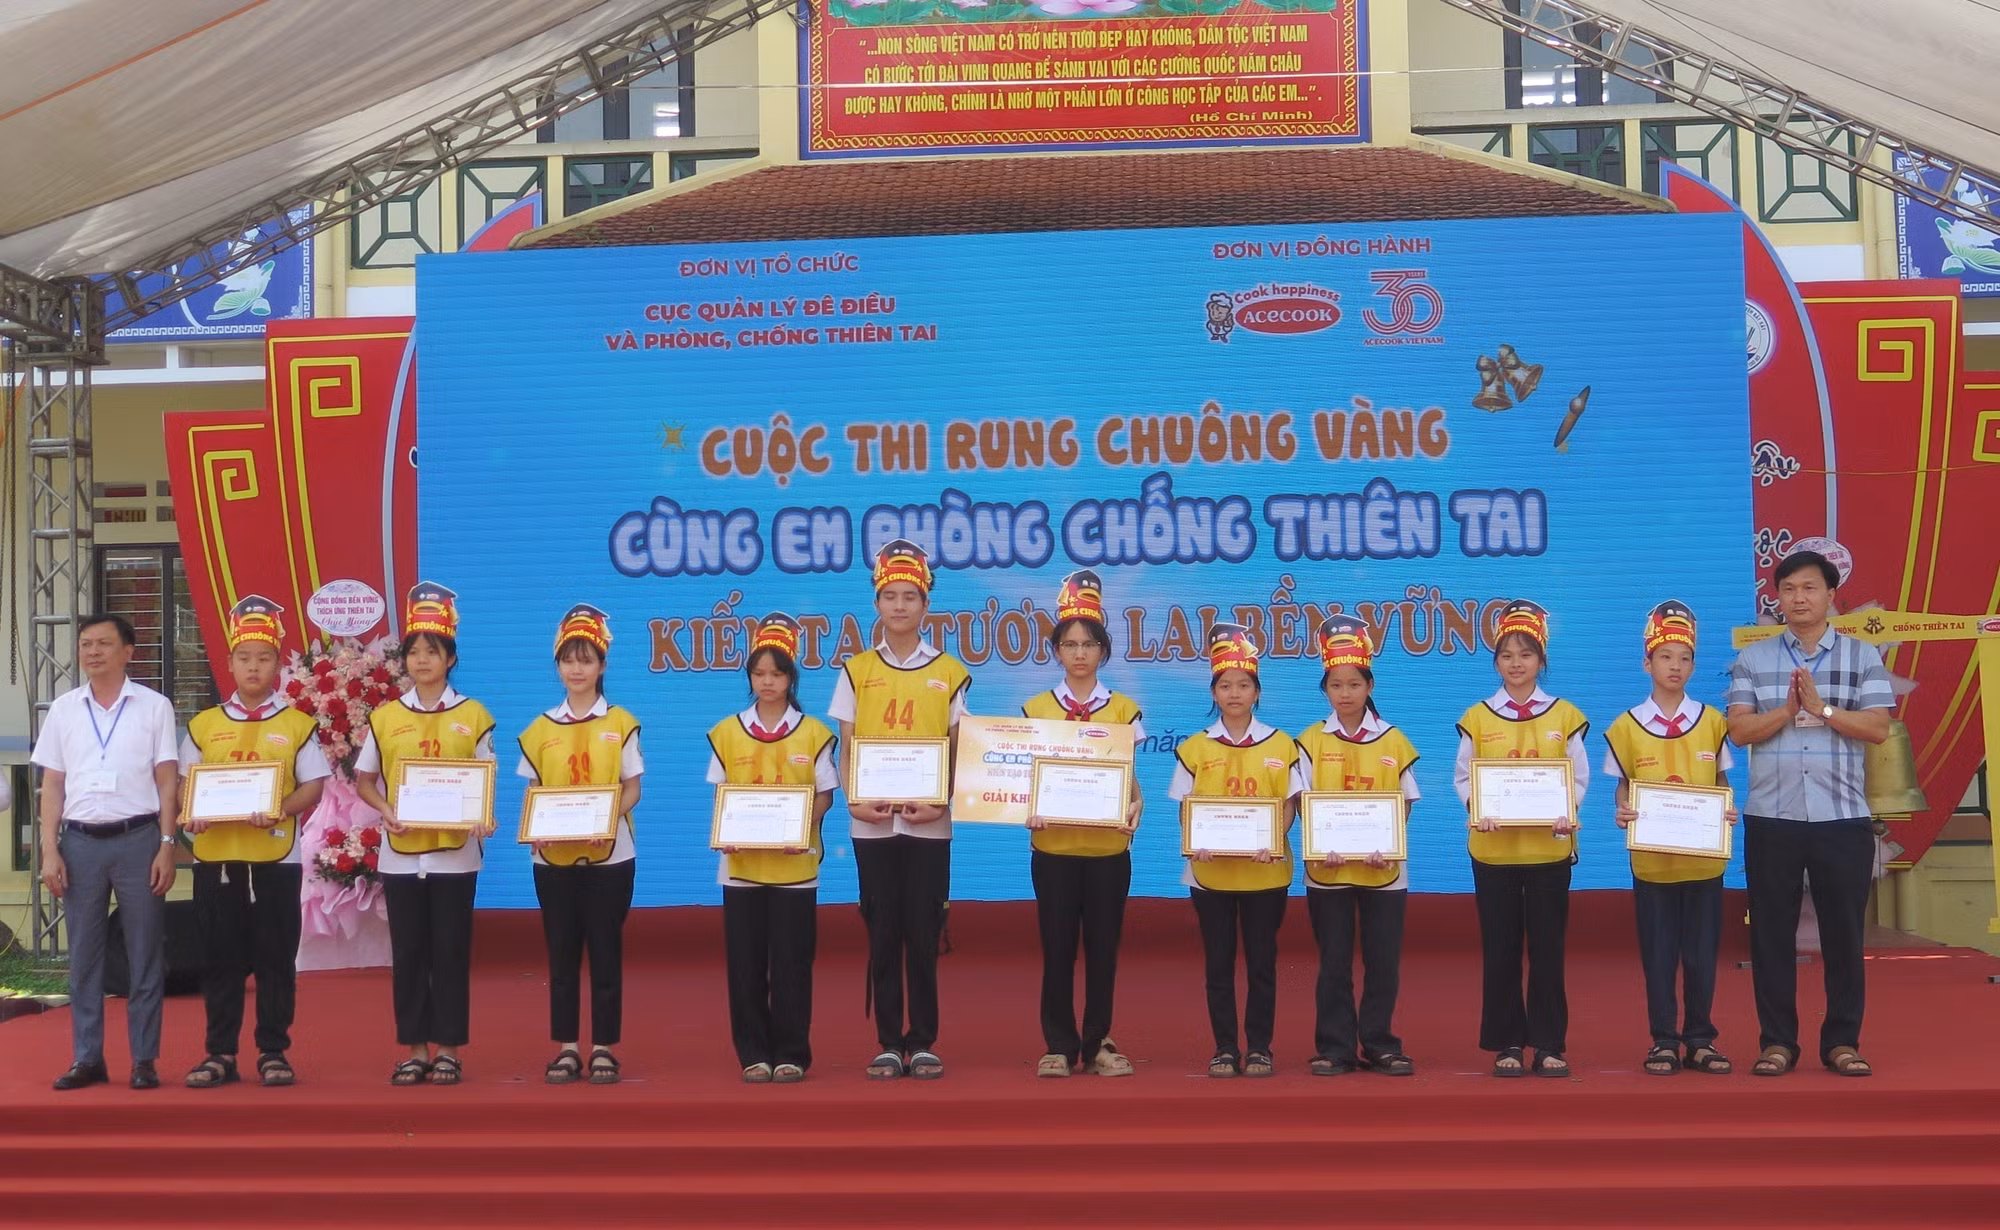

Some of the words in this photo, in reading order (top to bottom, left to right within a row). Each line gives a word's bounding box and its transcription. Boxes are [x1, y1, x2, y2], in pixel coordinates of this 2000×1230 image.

[905, 33, 937, 54] SÔNG
[939, 32, 965, 56] VIỆT
[968, 34, 995, 52] NAM
[999, 30, 1015, 51] CÓ
[1017, 26, 1040, 50] TRỞ
[1042, 29, 1067, 49] NÊN
[1071, 29, 1096, 49] TƯƠI
[1100, 30, 1122, 51] ĐẸP
[1126, 29, 1148, 47] HAY
[1152, 25, 1195, 47] KHÔNG,
[1199, 24, 1223, 45] DÂN
[1226, 23, 1249, 48] TỘC
[1252, 22, 1276, 46] VIỆT
[1280, 25, 1308, 42] NAM
[864, 61, 880, 84] CÓ
[883, 60, 914, 83] BƯỚC
[917, 60, 936, 82] TỚI
[939, 62, 958, 81] ĐÀI
[962, 64, 989, 81] VINH
[992, 62, 1032, 82] QUANG
[1035, 55, 1051, 80] ĐỂ
[1054, 58, 1085, 78] SÁNH
[1089, 60, 1107, 77] VAI
[1111, 54, 1129, 76] VỚI
[1134, 54, 1157, 75] CÁC
[1160, 54, 1200, 75] CƯỜNG
[1204, 50, 1235, 75] QUỐC
[1239, 52, 1266, 72] NĂM
[1270, 51, 1302, 72] CHÂU
[844, 95, 875, 118] ĐƯỢC
[880, 97, 902, 113] HAY
[905, 92, 948, 113] KHÔNG,
[951, 90, 987, 111] CHÍNH
[991, 88, 1005, 110] LÀ
[1008, 87, 1033, 109] NHỜ
[1036, 88, 1060, 112] MỘT
[1064, 85, 1096, 108] PHẦN
[1099, 84, 1122, 106] LỚN
[1126, 82, 1134, 105] Ở
[1137, 84, 1169, 105] CÔNG
[1172, 87, 1196, 108] HỌC
[1199, 83, 1221, 108] TẬP
[1225, 78, 1249, 103] CỦA
[1252, 80, 1275, 102] CÁC
[1190, 111, 1220, 123] (Hồ
[1226, 111, 1255, 122] Chí
[1262, 111, 1313, 122] Minh)
[1213, 240, 1262, 259] ĐƠN
[1268, 242, 1290, 260] VỊ
[1296, 235, 1361, 257] ĐỒNG
[1368, 234, 1432, 254] HÀNH
[679, 258, 728, 277] ĐƠN
[735, 258, 756, 279] VỊ
[762, 252, 791, 274] TỔ
[796, 252, 859, 272] CHỨC
[645, 304, 690, 325] CỤC
[698, 296, 763, 322] QUẢN
[770, 295, 797, 318] LÝ
[803, 295, 835, 315] ĐÊ
[840, 291, 895, 315] ĐIỀU
[1235, 285, 1269, 303] Cook
[1272, 284, 1340, 301] happiness
[605, 329, 639, 351] VÀ
[644, 329, 731, 351] PHÒNG,
[737, 324, 818, 346] CHỐNG
[825, 323, 892, 343] THIÊN
[899, 324, 937, 341] TAI
[702, 413, 831, 486] CUỘC
[846, 422, 928, 474] THI
[946, 418, 1079, 472] RUNG
[1097, 401, 1297, 464] CHUÔNG
[1314, 397, 1449, 460] VÀNG
[610, 496, 763, 577] CÙNG
[772, 506, 853, 574] EM
[862, 488, 1053, 572] PHÒNG
[1062, 471, 1257, 566] CHỐNG
[1263, 477, 1440, 562] THIÊN
[1449, 487, 1547, 558] TAI
[1893, 622, 1921, 632] CHỐNG
[1923, 621, 1948, 631] THIÊN
[1949, 622, 1965, 630] TAI
[883, 698, 914, 731] 44
[983, 789, 1008, 802] GIẢI
